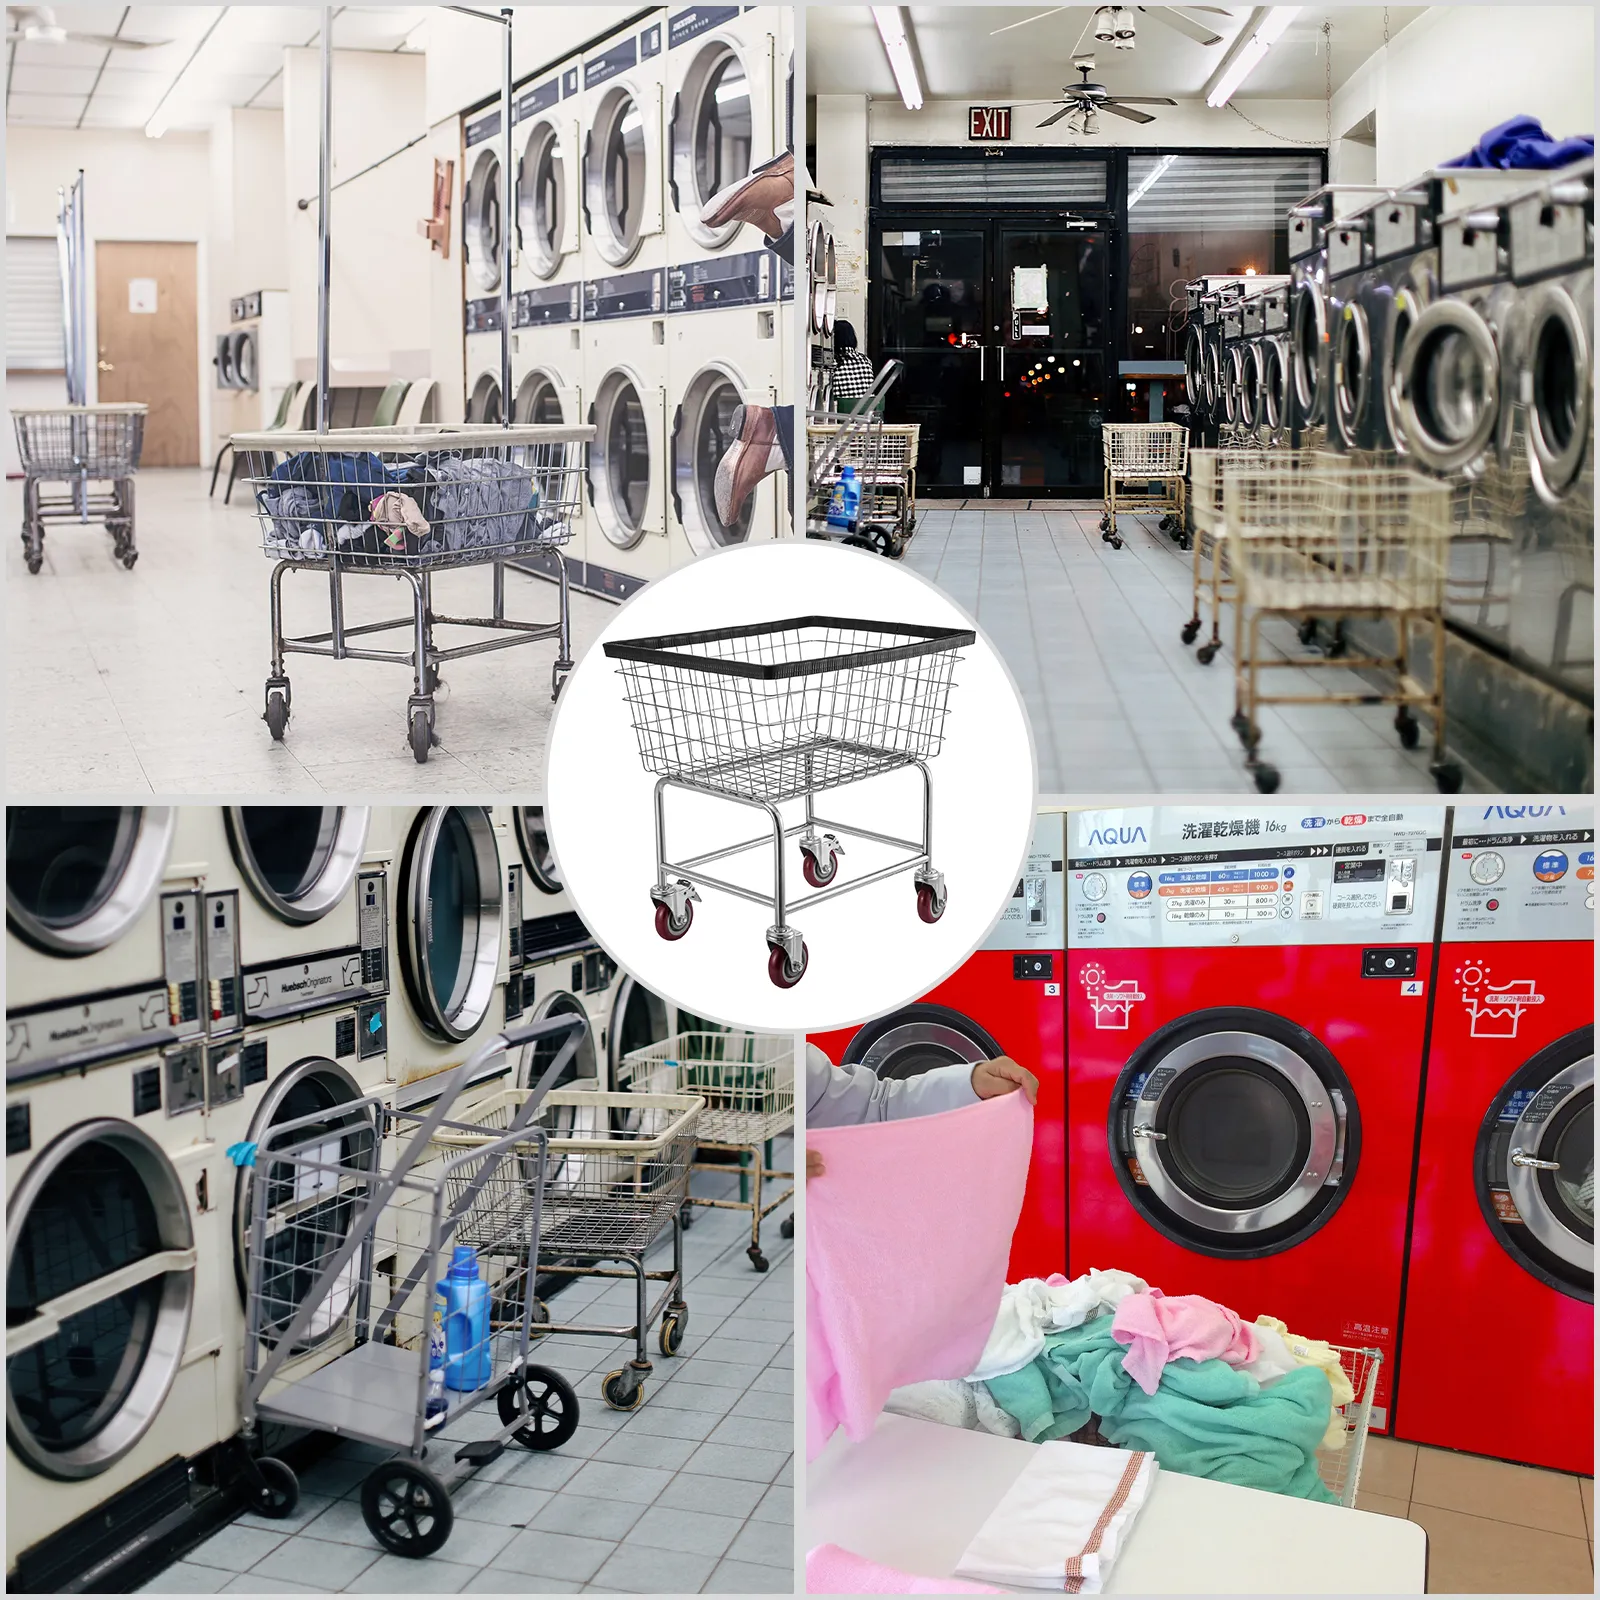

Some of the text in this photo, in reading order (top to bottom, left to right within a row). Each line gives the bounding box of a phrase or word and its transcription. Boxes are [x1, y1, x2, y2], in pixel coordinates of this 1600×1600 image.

[971, 109, 1009, 137] EXIT
[1182, 818, 1287, 840] 洗濯乾燥機 16kg
[1088, 826, 1147, 847] AQUA
[1532, 833, 1578, 843] 洗濯物を入れる
[1344, 861, 1363, 870] 営業中
[1542, 861, 1559, 870] 標準
[281, 975, 332, 994] HuebschOriginators
[1048, 984, 1056, 994] 3
[1407, 983, 1416, 994] 4
